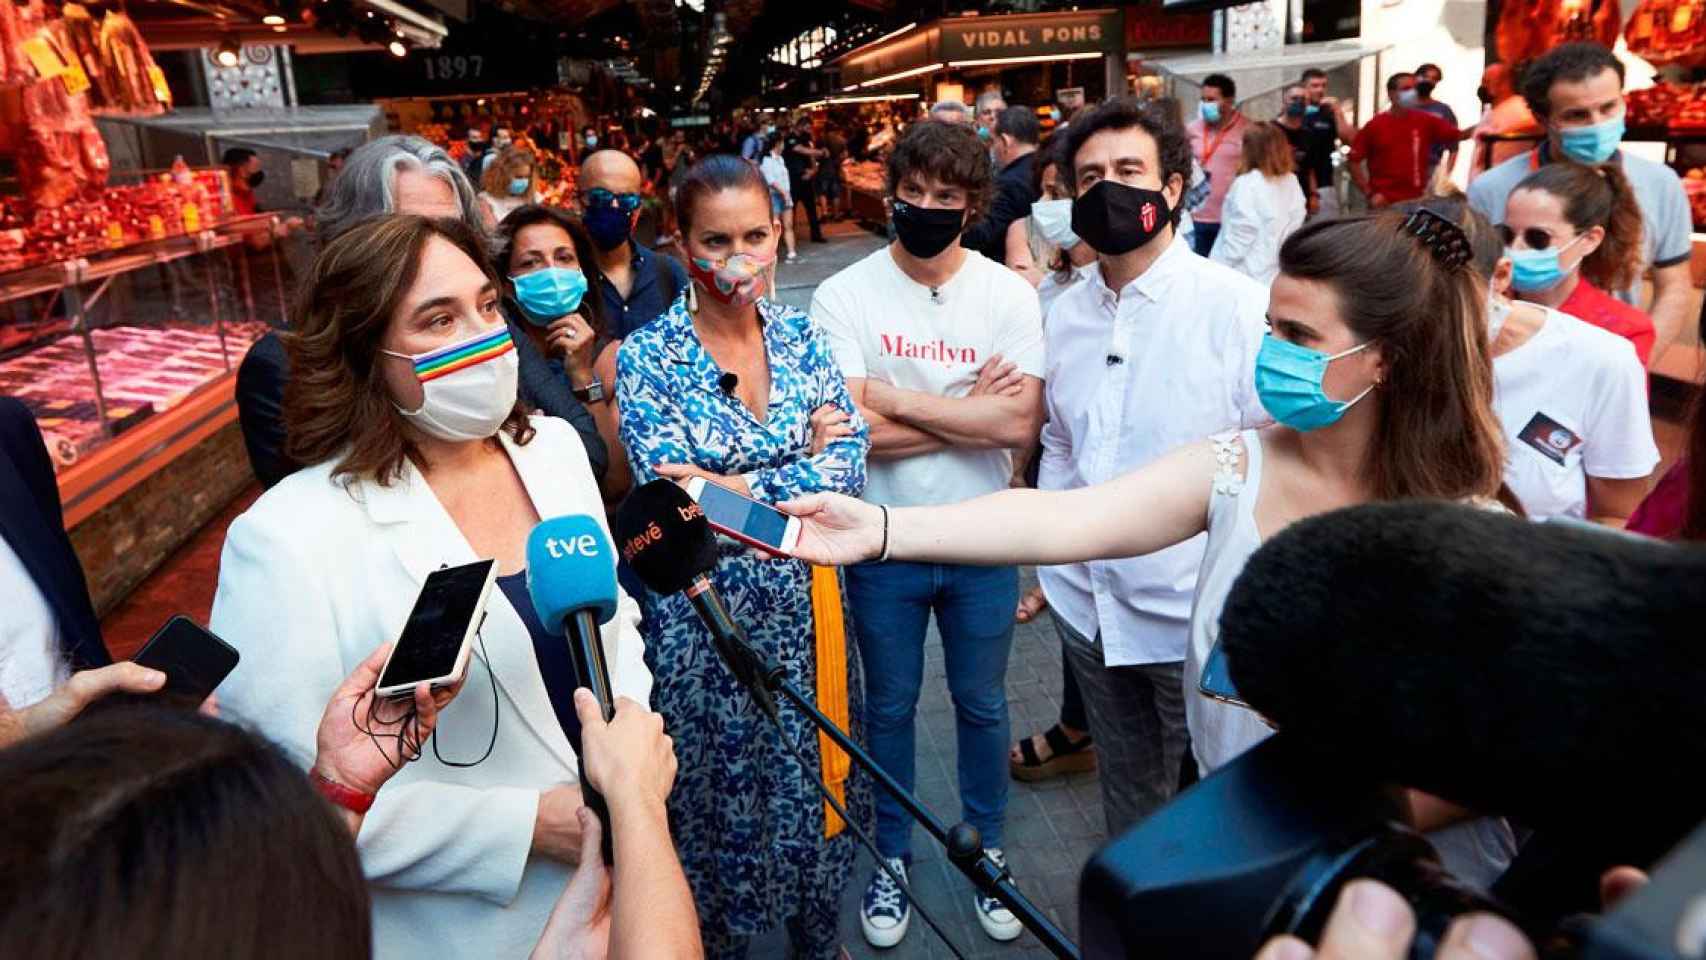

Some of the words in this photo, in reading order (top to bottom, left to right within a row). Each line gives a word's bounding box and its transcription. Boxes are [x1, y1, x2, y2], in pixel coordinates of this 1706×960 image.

[962, 30, 1031, 49] VIDAL
[1042, 25, 1102, 43] PONS
[424, 55, 484, 80] 1897
[879, 333, 976, 369] Marilyn
[545, 534, 599, 558] tve
